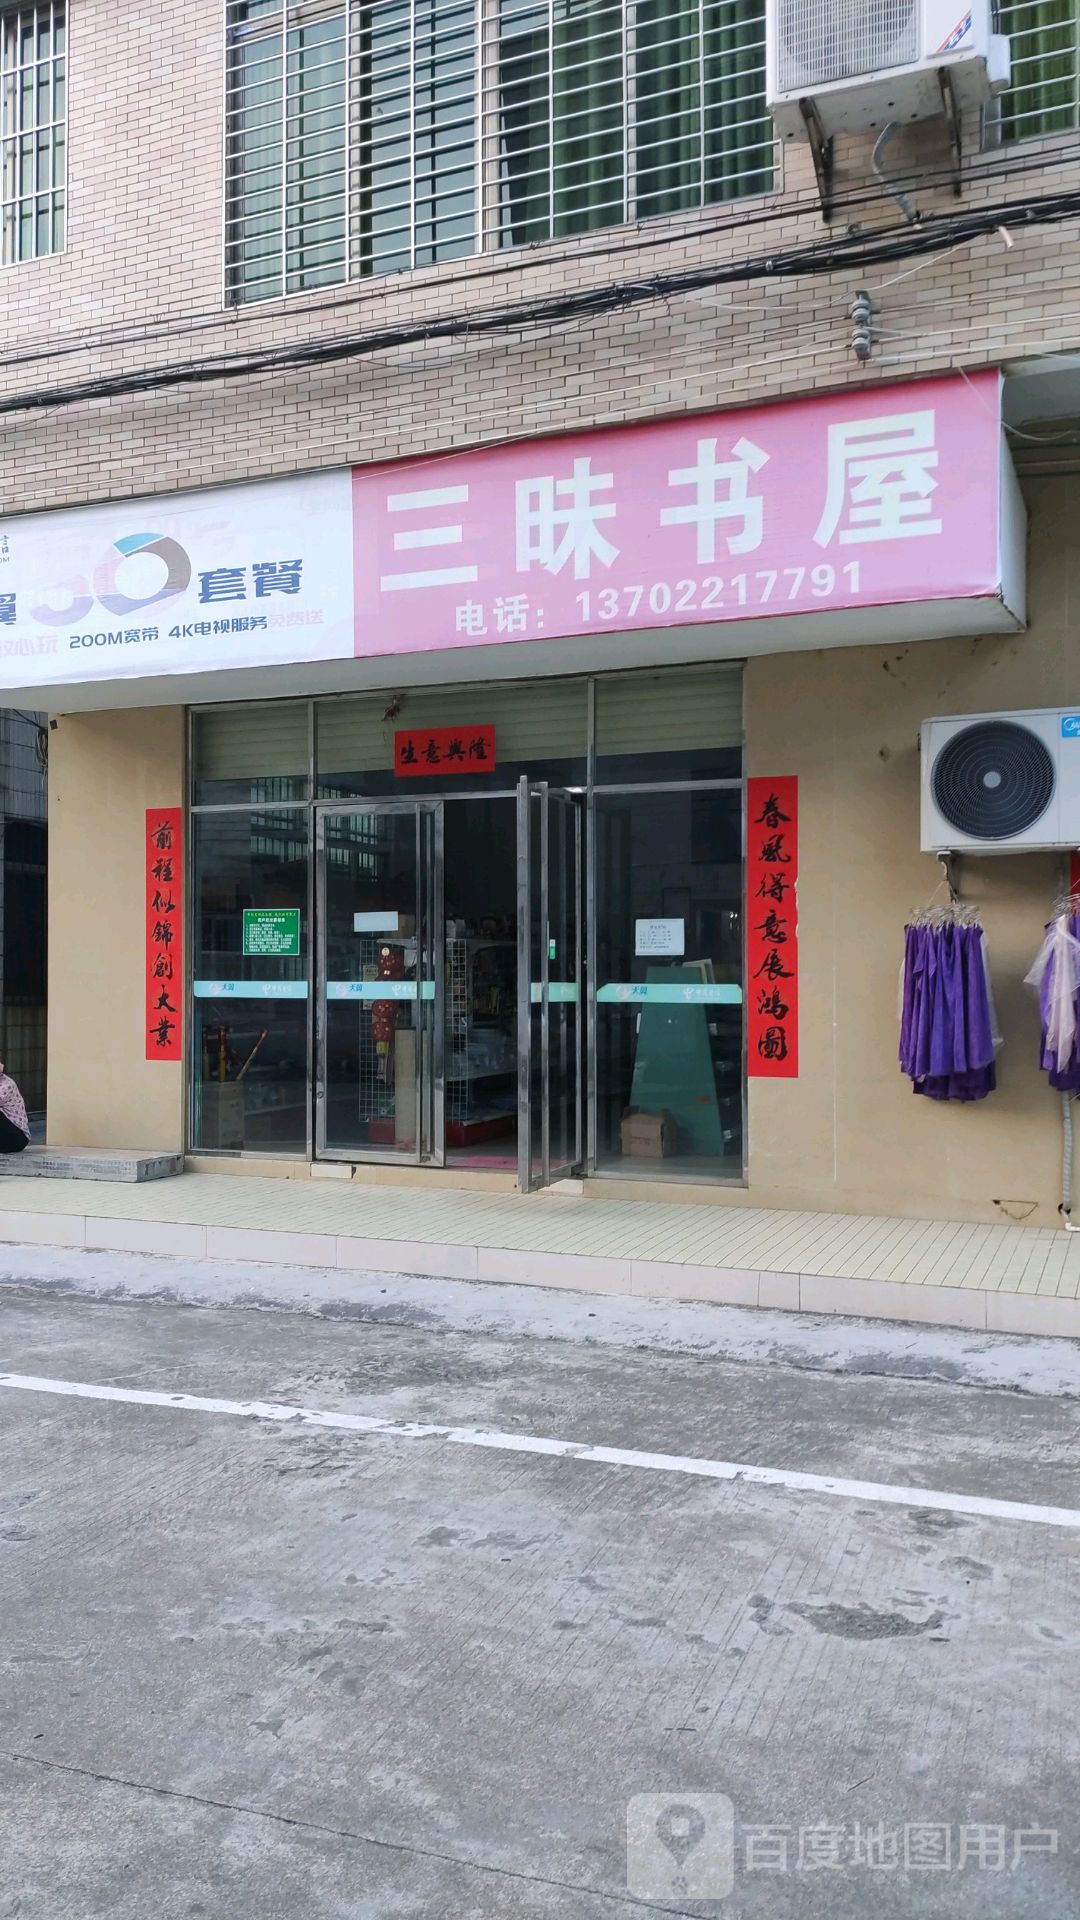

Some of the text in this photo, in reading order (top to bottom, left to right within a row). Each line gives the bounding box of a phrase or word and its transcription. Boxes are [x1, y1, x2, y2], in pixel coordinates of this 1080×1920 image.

[379, 409, 943, 592] 三昧书屋
[198, 559, 303, 604] 套餐
[574, 561, 861, 622] 13702217791
